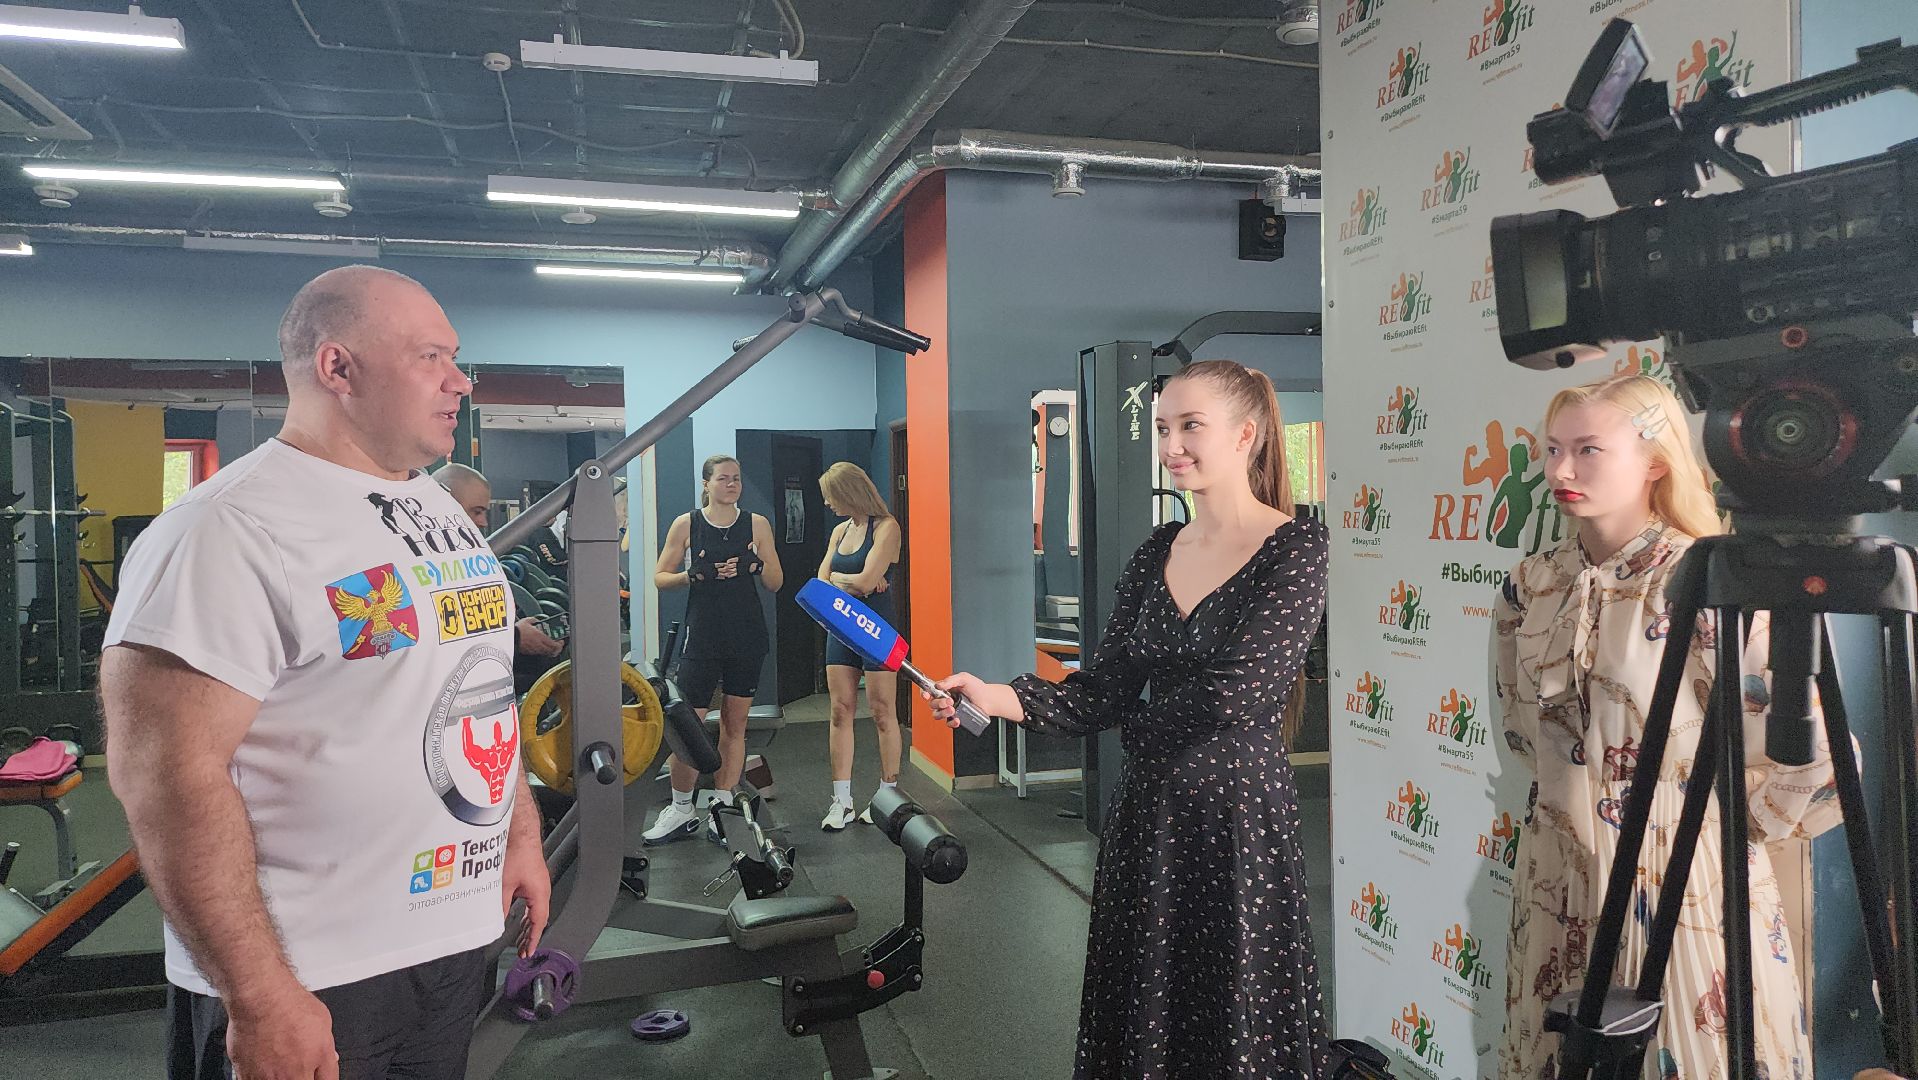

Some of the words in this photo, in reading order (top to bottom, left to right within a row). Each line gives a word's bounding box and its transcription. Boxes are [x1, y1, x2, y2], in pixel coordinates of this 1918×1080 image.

[1428, 493, 1483, 541] RE
[1441, 562, 1509, 590] #Выбир
[463, 601, 507, 631] SHOP
